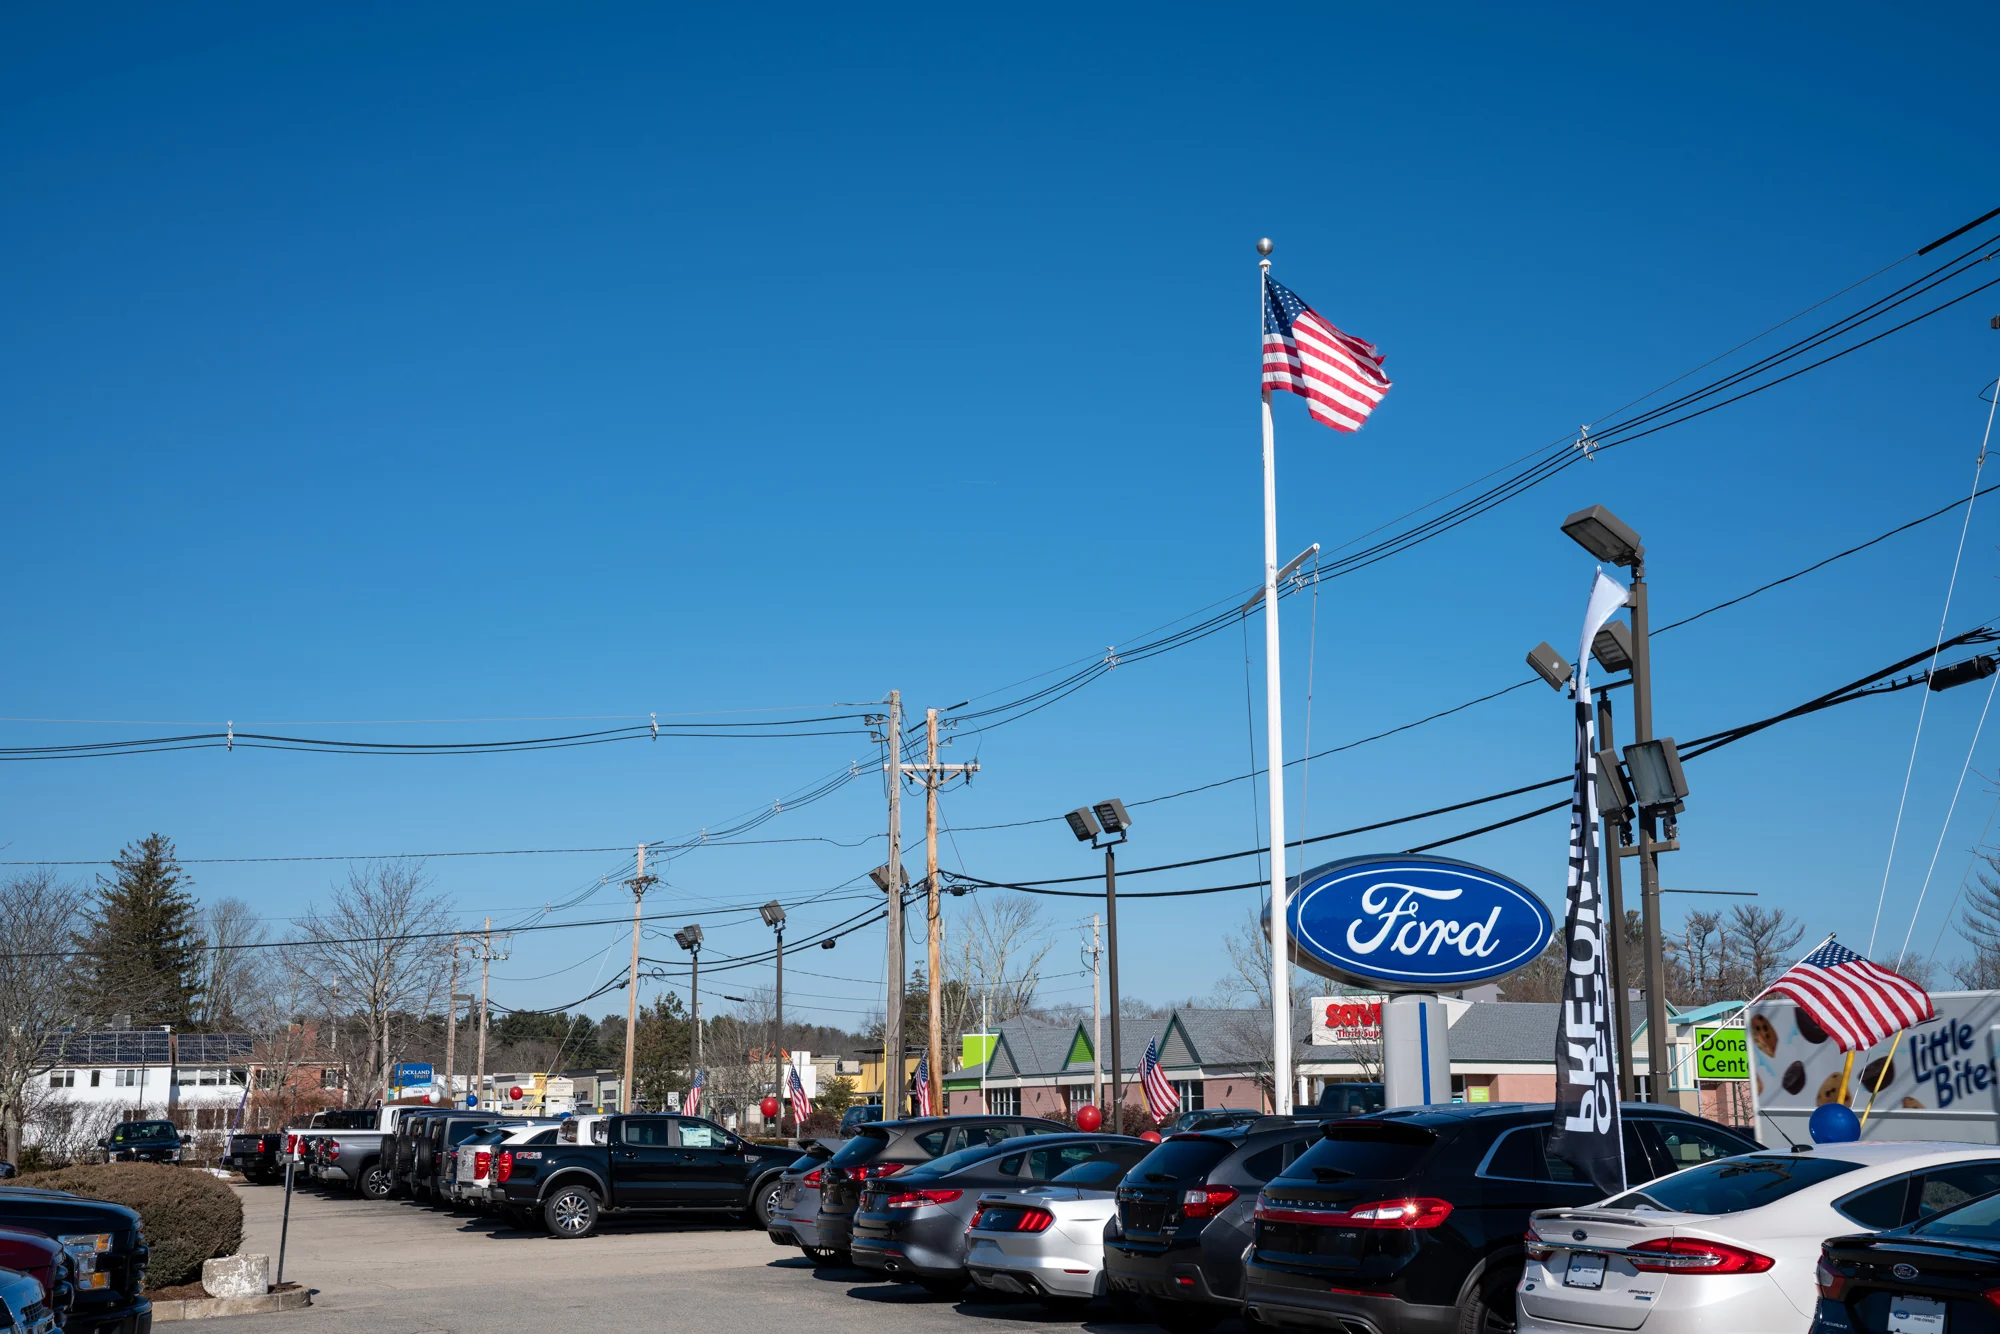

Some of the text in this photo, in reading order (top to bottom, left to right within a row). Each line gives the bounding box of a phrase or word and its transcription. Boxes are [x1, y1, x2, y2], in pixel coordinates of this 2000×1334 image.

[1346, 882, 1502, 957] Ford
[1325, 1003, 1382, 1028] SAV
[1909, 1017, 1974, 1084] Little
[1702, 1054, 1750, 1073] Cent
[1272, 1199, 1337, 1208] LINCOLN
